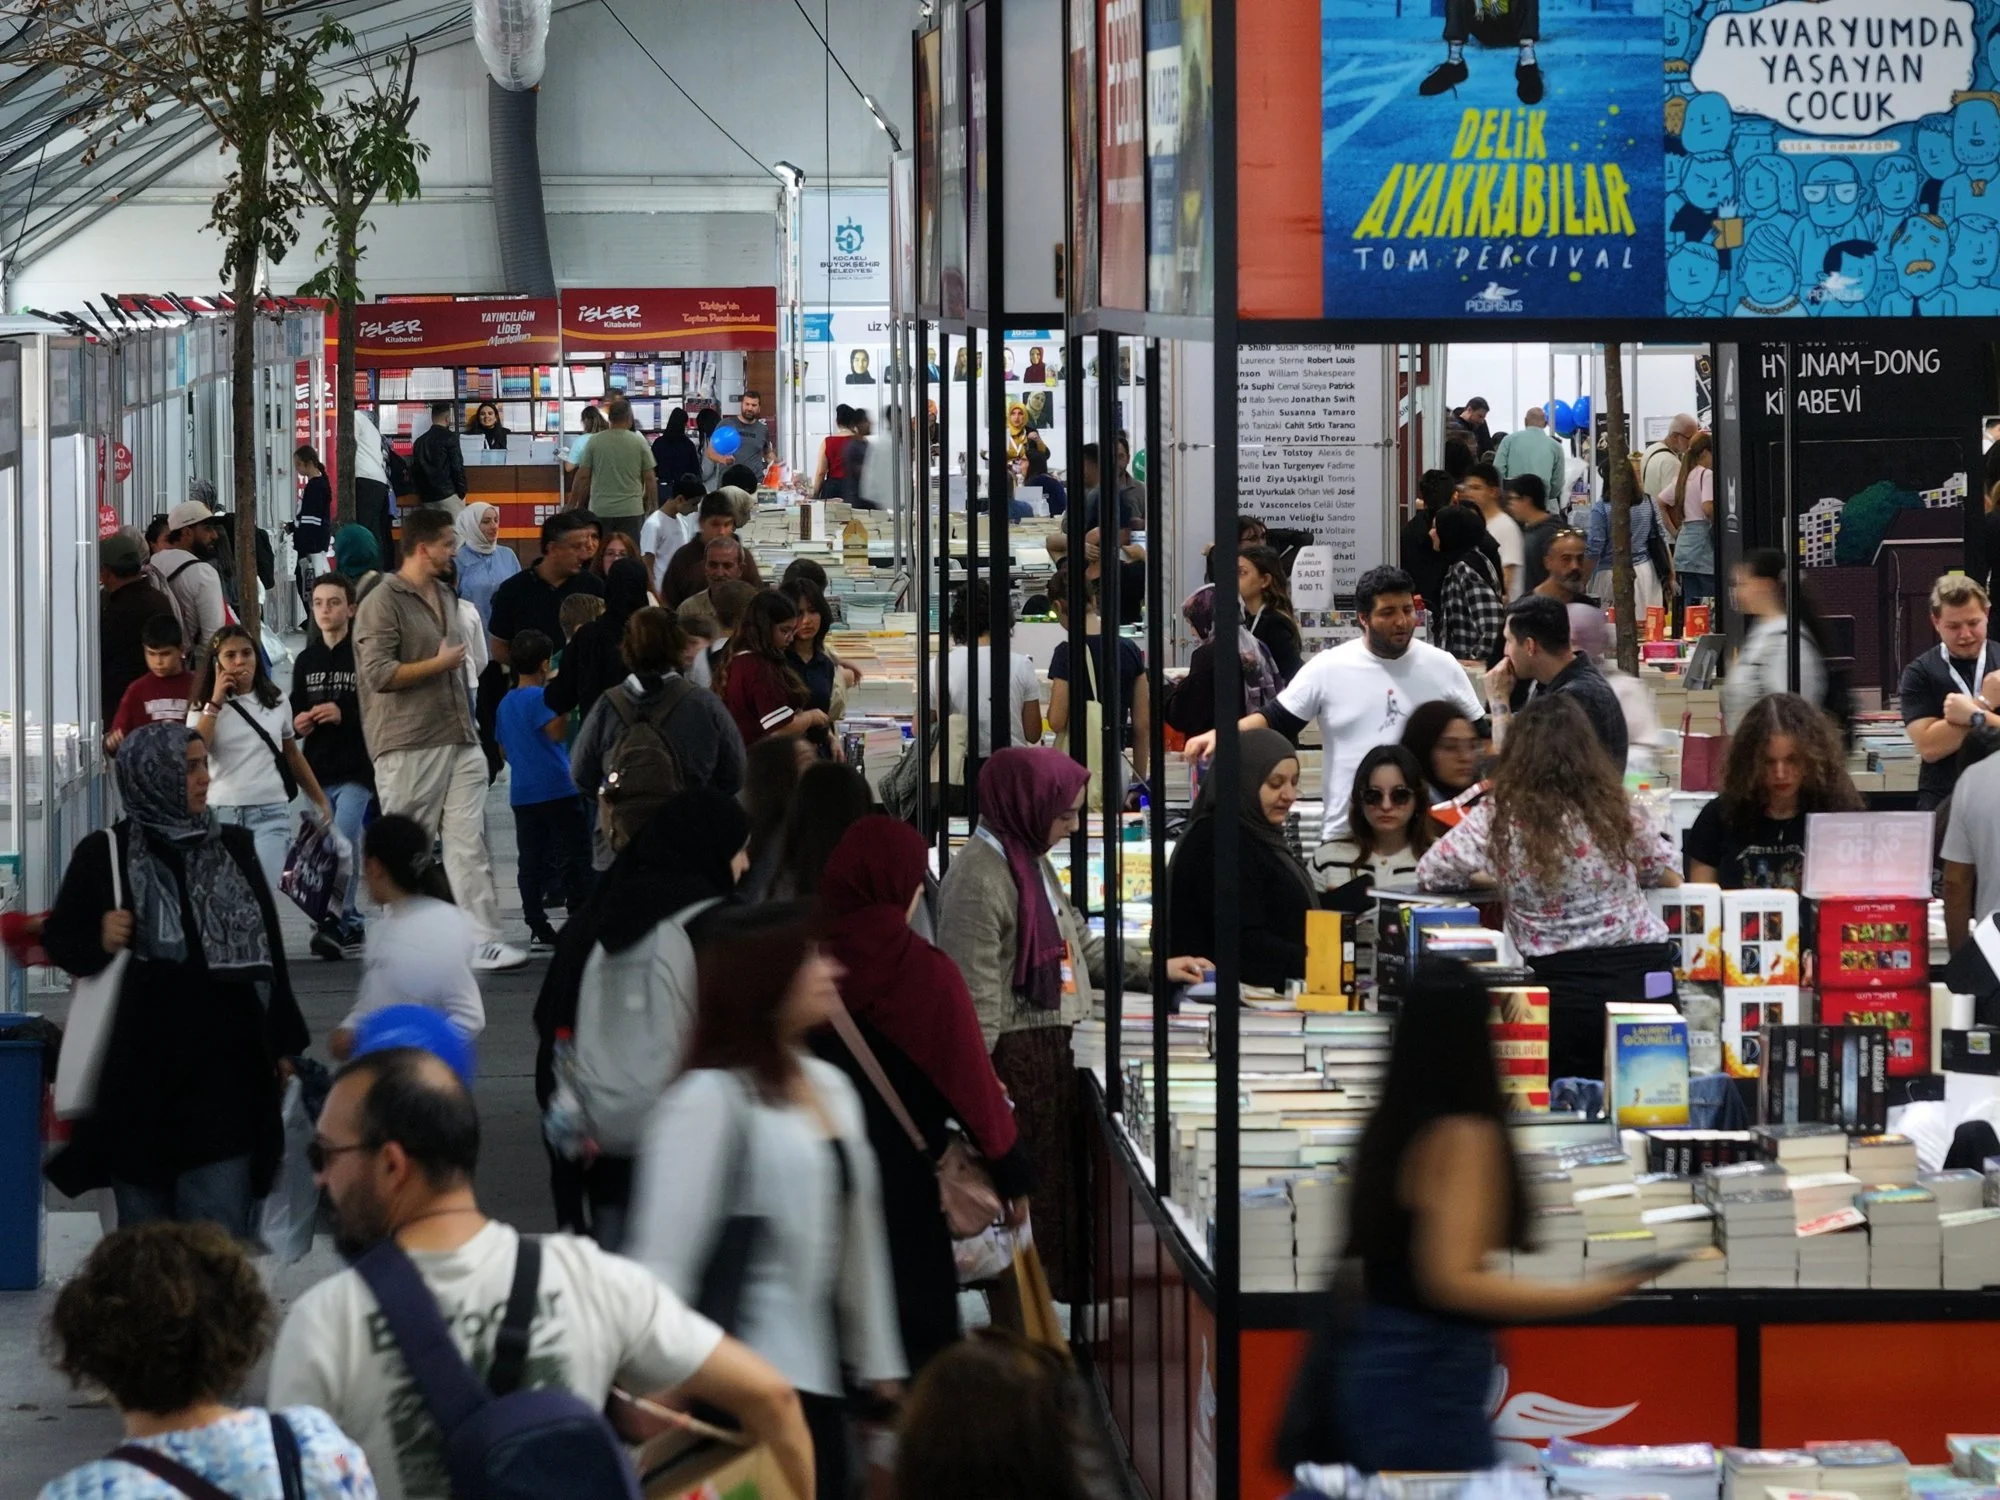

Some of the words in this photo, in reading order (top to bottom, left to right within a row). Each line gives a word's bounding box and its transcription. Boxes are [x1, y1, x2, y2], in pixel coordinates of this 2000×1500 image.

[1725, 17, 1963, 49] AKVARYUMDA
[1761, 53, 1922, 84] YAŞAYAN
[1787, 91, 1895, 123] ÇOCUK
[1451, 107, 1547, 160] DELİK
[1352, 163, 1637, 239] AYAKKABILAR
[1353, 246, 1429, 272] TOM
[1456, 245, 1633, 271] PERCIVAL
[1465, 300, 1523, 313] PEGASUS
[481, 310, 535, 323] YAYINCILIĞIN
[578, 304, 642, 323] İŞLER
[359, 319, 423, 338] İŞLER
[497, 323, 521, 335] LİDER
[604, 321, 641, 329] Kitabevleri
[867, 320, 882, 332] LİZ
[385, 336, 423, 344] Kitabevleri
[1302, 344, 1332, 353] Sontag
[1268, 369, 1299, 377] William
[1303, 369, 1355, 378] Shakespeare
[1252, 383, 1274, 391] Suphi
[1329, 382, 1355, 390] Patrick
[1291, 395, 1331, 403] Jonathan
[1334, 395, 1355, 403] Swift
[1765, 385, 1861, 415] KİABEVİ
[1251, 408, 1275, 419] Şahin
[1265, 435, 1291, 443] Henry
[1240, 449, 1260, 459] Tunç
[1263, 449, 1277, 457] Lev
[1283, 449, 1313, 458] Tolstoy
[1318, 449, 1342, 457] Alexis
[1344, 449, 1355, 457] de
[1262, 461, 1280, 470] İvan
[1283, 462, 1325, 471] Turgenyev
[1327, 462, 1355, 470] Fadime
[1267, 475, 1284, 484] Ziya
[1287, 475, 1323, 484] Uşaklıgil
[1256, 488, 1295, 497] Uyurkulak
[1337, 487, 1355, 495] José
[1290, 514, 1324, 523] Velioğlu
